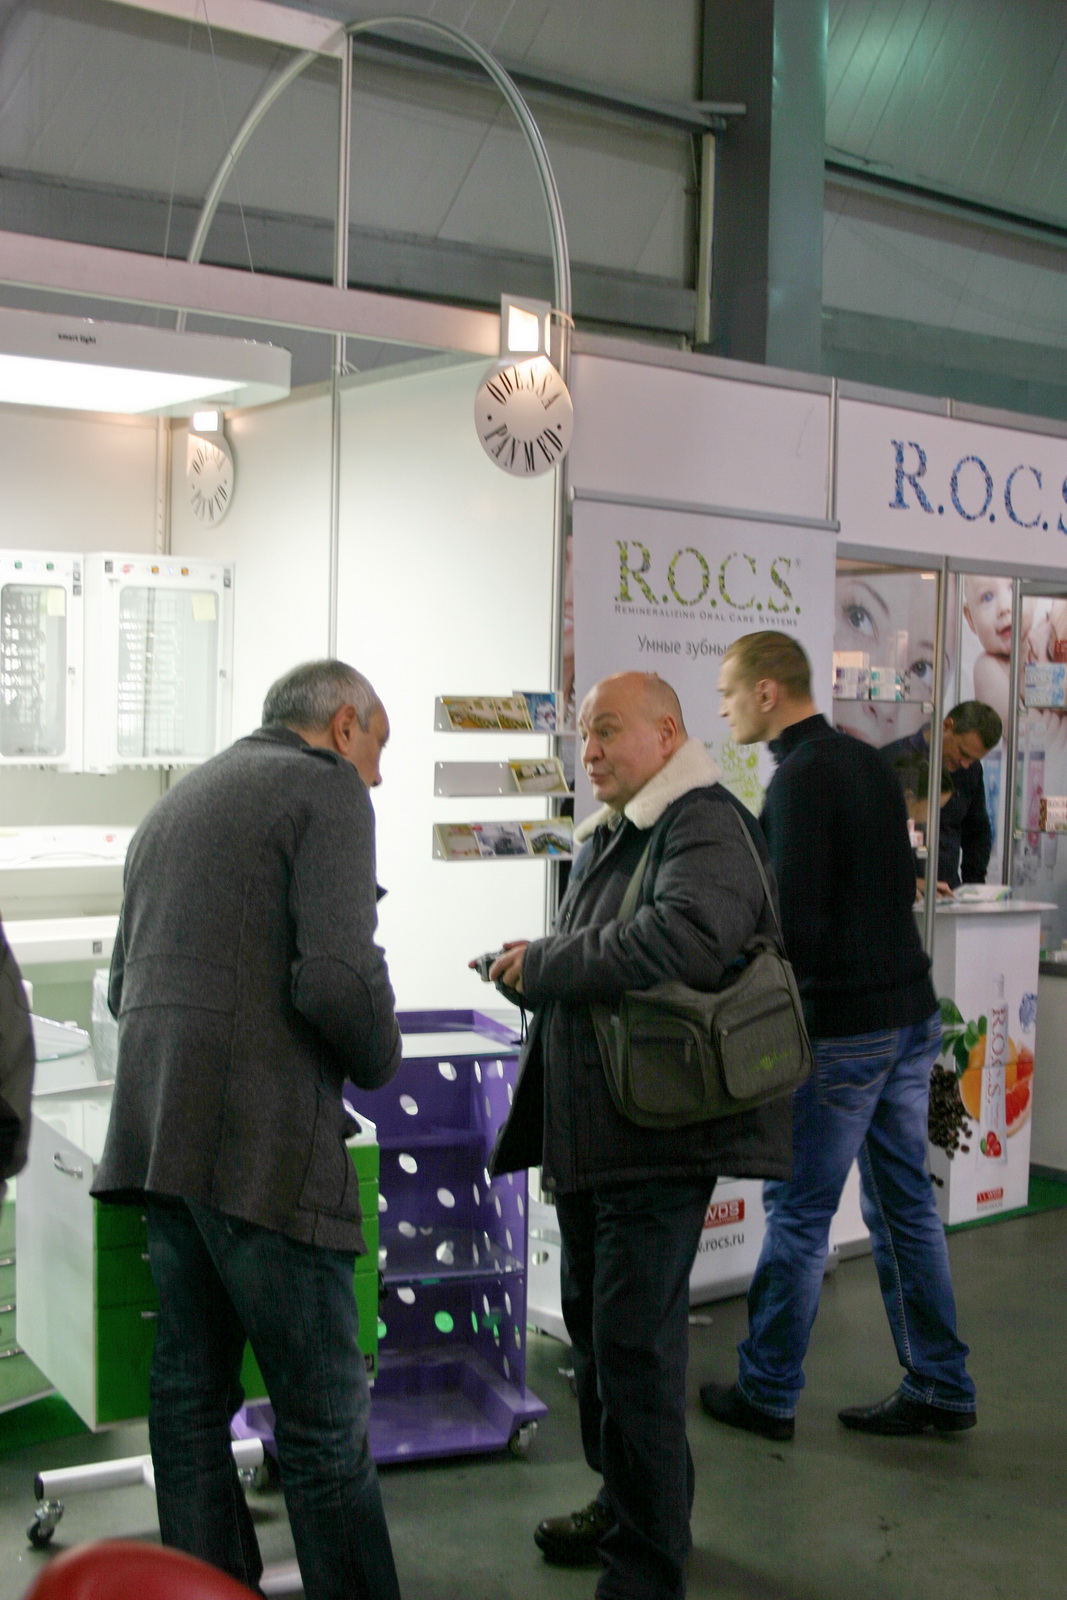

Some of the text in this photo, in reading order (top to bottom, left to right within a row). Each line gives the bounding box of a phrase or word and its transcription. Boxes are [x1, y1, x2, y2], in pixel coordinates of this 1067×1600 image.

[80, 334, 97, 345] light
[614, 539, 802, 614] R.O.C.S.
[699, 611, 725, 622] ORAL
[729, 613, 756, 624] CARE
[637, 634, 682, 655] Умные
